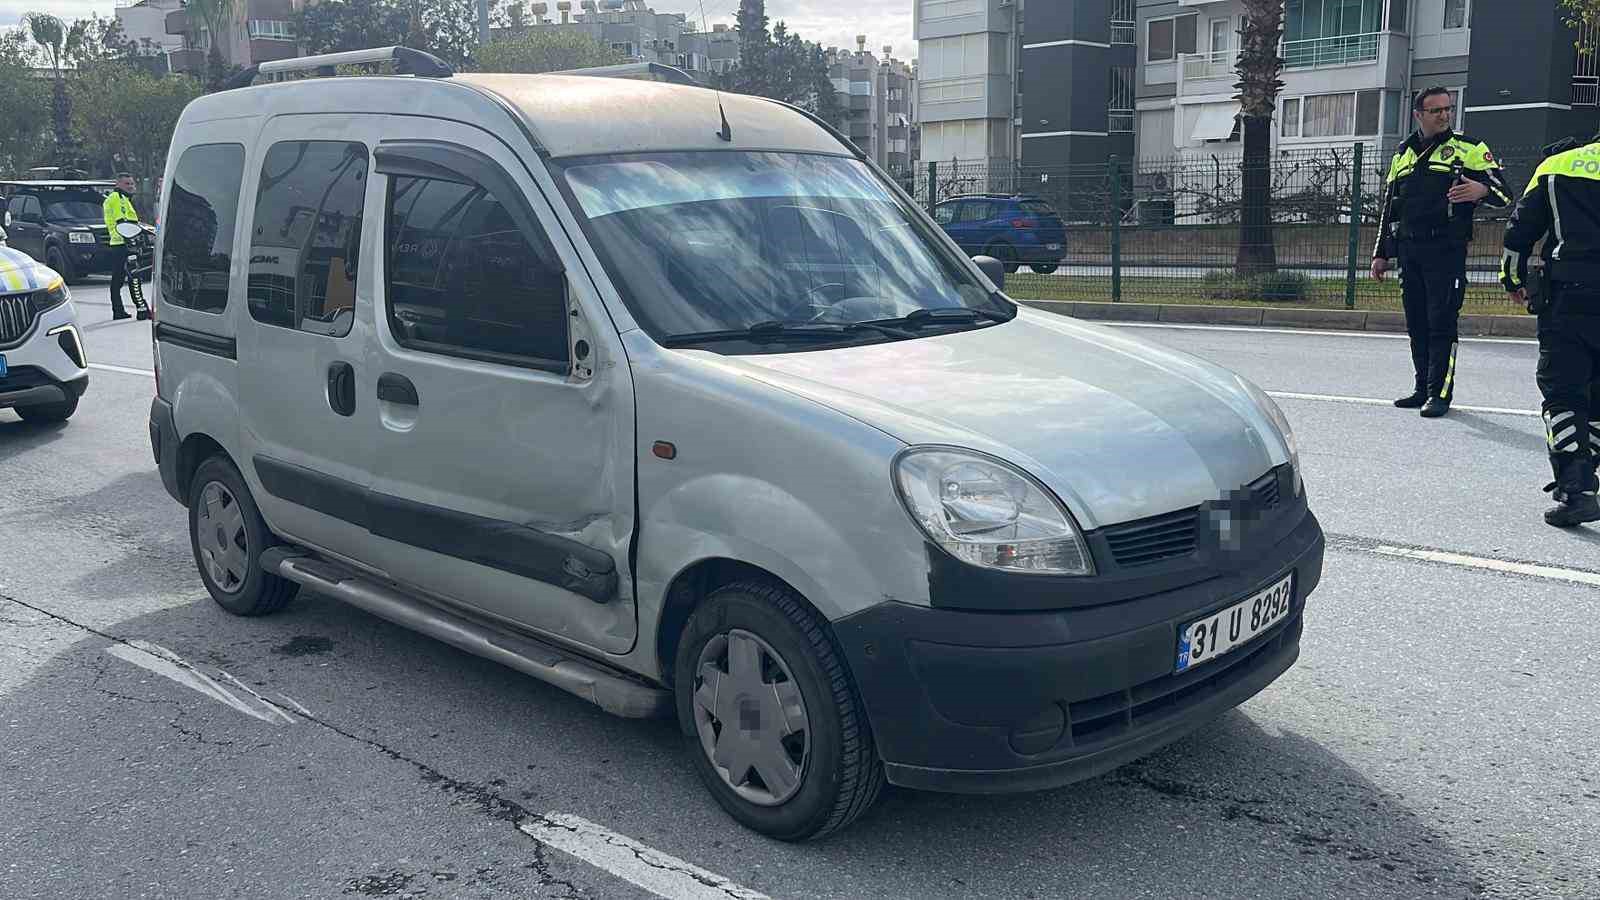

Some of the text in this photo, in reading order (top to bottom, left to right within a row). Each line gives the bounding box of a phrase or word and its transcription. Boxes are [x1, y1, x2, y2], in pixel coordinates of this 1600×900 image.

[1571, 159, 1600, 174] PO
[1192, 581, 1289, 659] 31 U 8292
